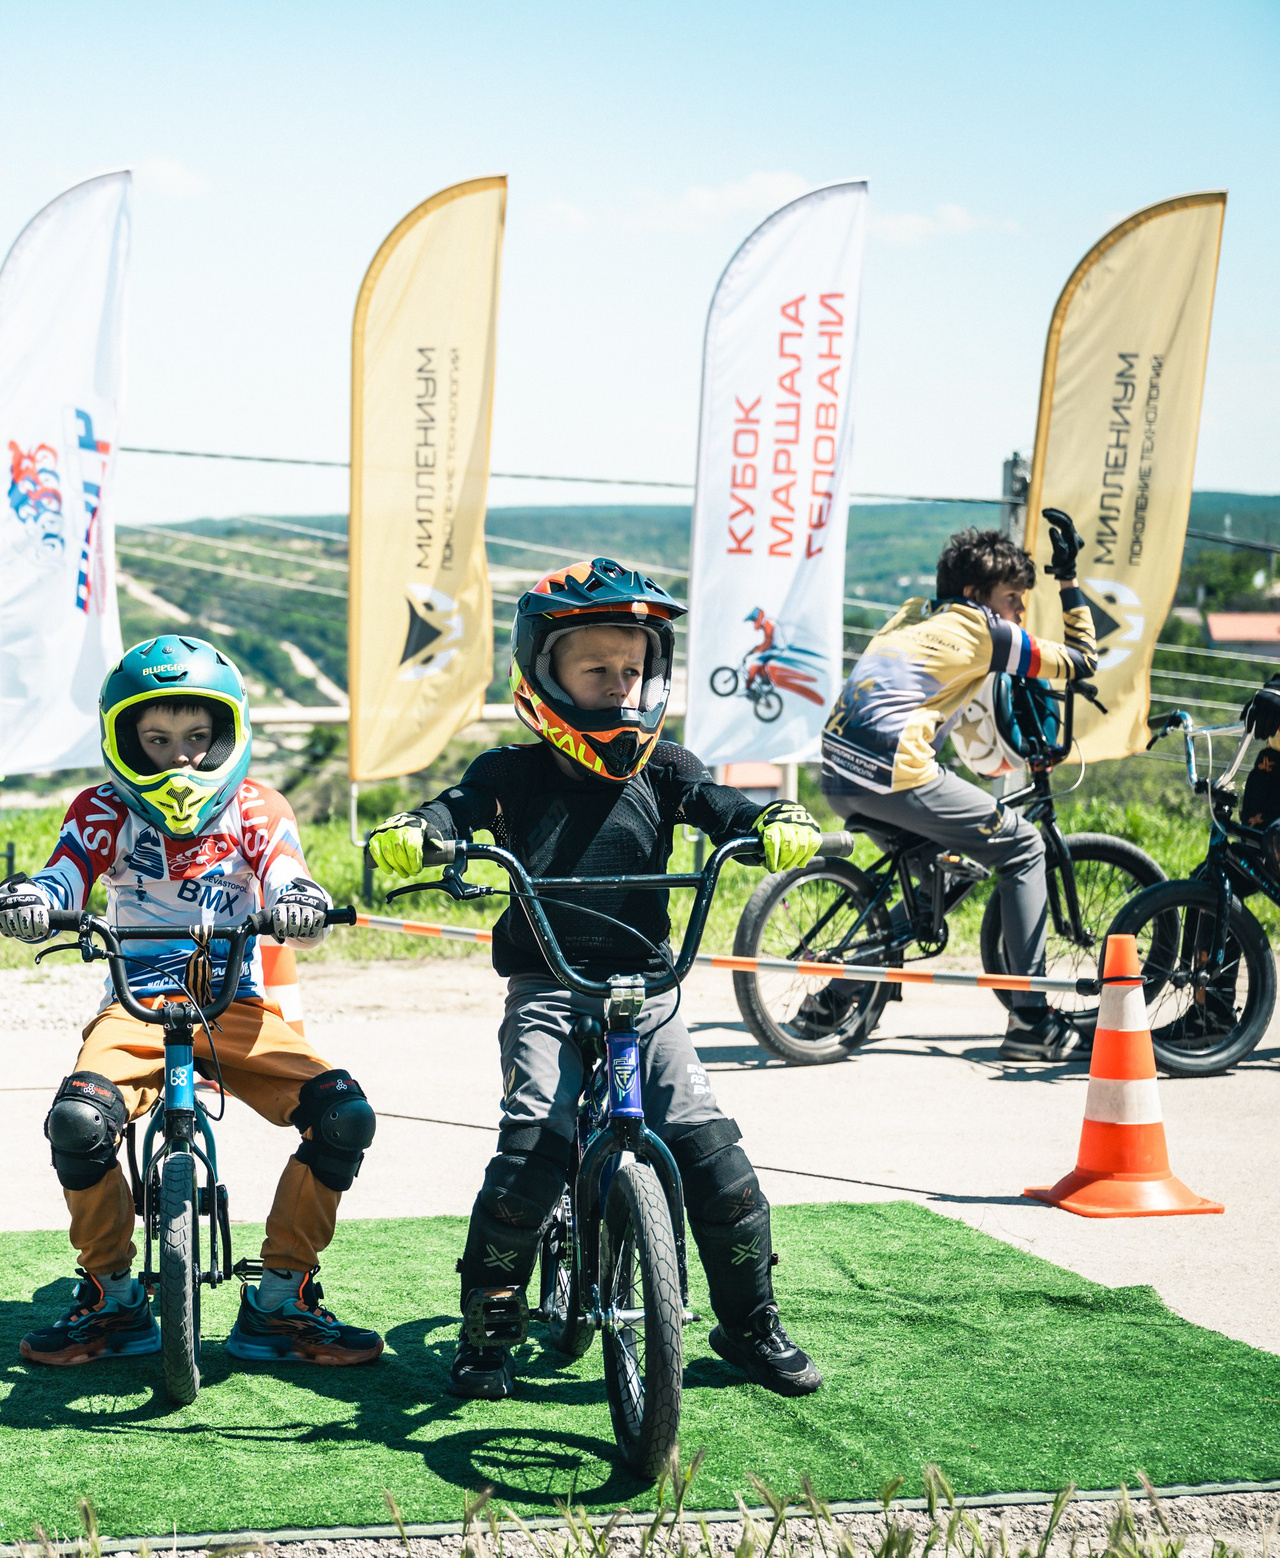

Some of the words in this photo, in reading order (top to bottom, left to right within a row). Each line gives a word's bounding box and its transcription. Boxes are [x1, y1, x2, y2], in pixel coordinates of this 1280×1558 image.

[414, 347, 437, 570] МИЛЛЕНИУМ
[726, 394, 762, 556] КУБОК
[768, 294, 807, 559] МАРШАЛА
[804, 292, 845, 560] ГЕЛОВАНИ
[1093, 352, 1140, 567] МИЛЛЕНИУМ
[1128, 466, 1152, 568] ПОКОЛЕНИЕ
[1140, 353, 1165, 462] ТЕХНОЛОГИЙ
[541, 719, 604, 773] KALI
[177, 878, 239, 917] BMX
